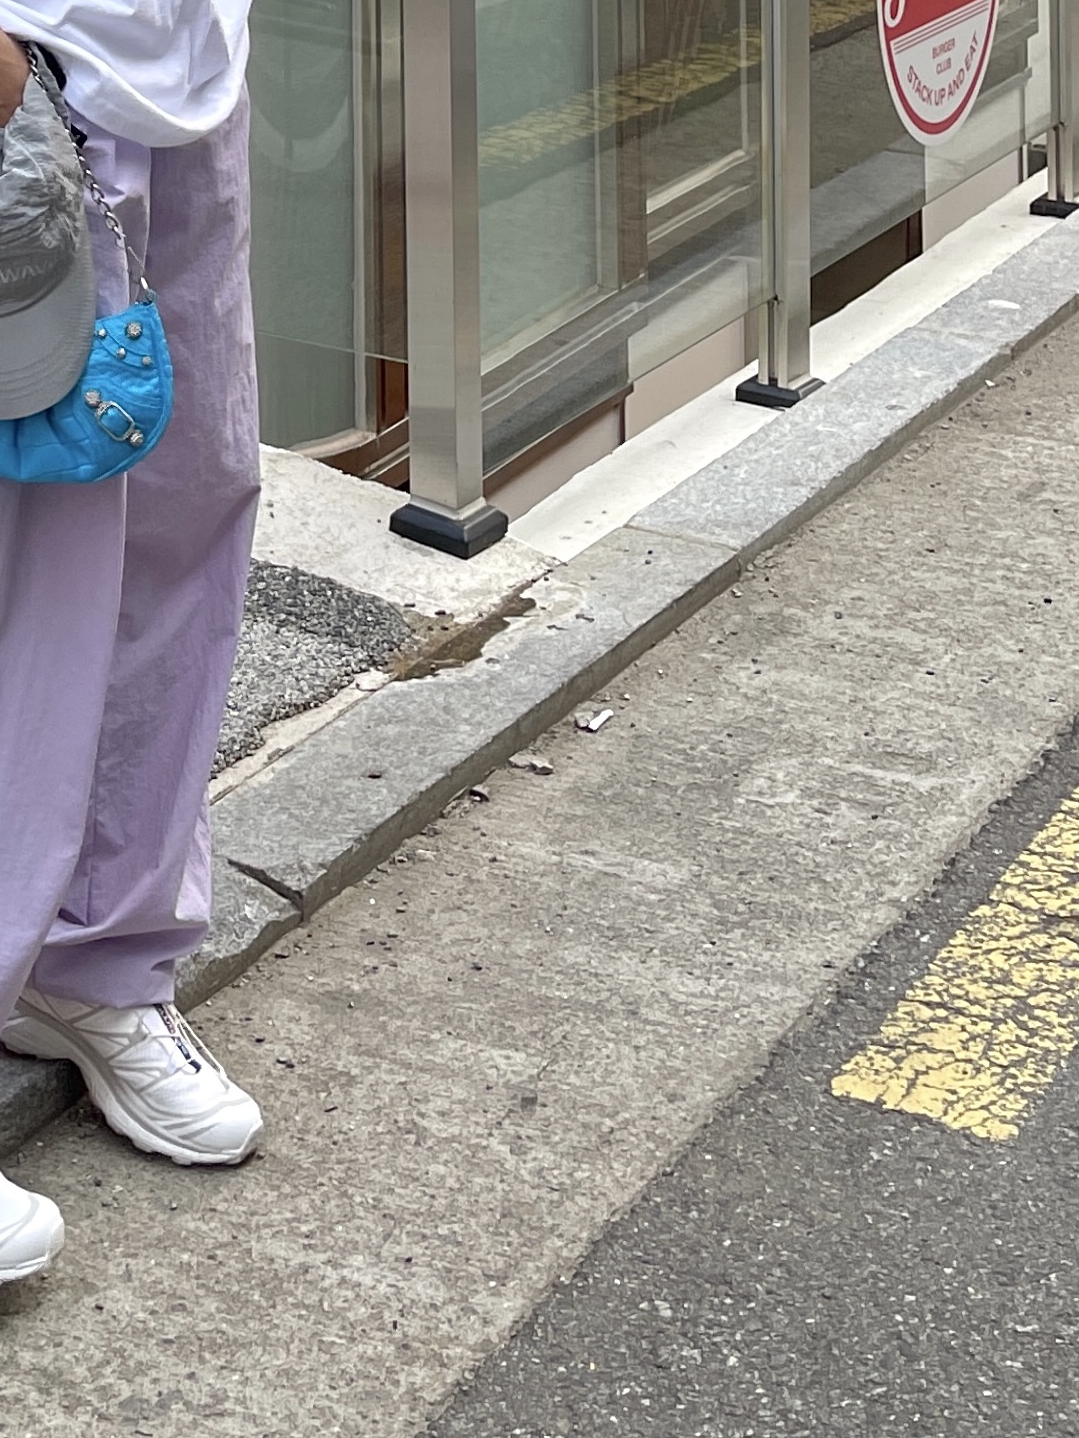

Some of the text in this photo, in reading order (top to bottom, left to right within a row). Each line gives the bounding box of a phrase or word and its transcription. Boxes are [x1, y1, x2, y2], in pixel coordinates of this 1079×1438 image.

[932, 37, 956, 59] BURGER
[907, 30, 978, 106] STACK UP AND EAT
[936, 57, 952, 75] CLUB
